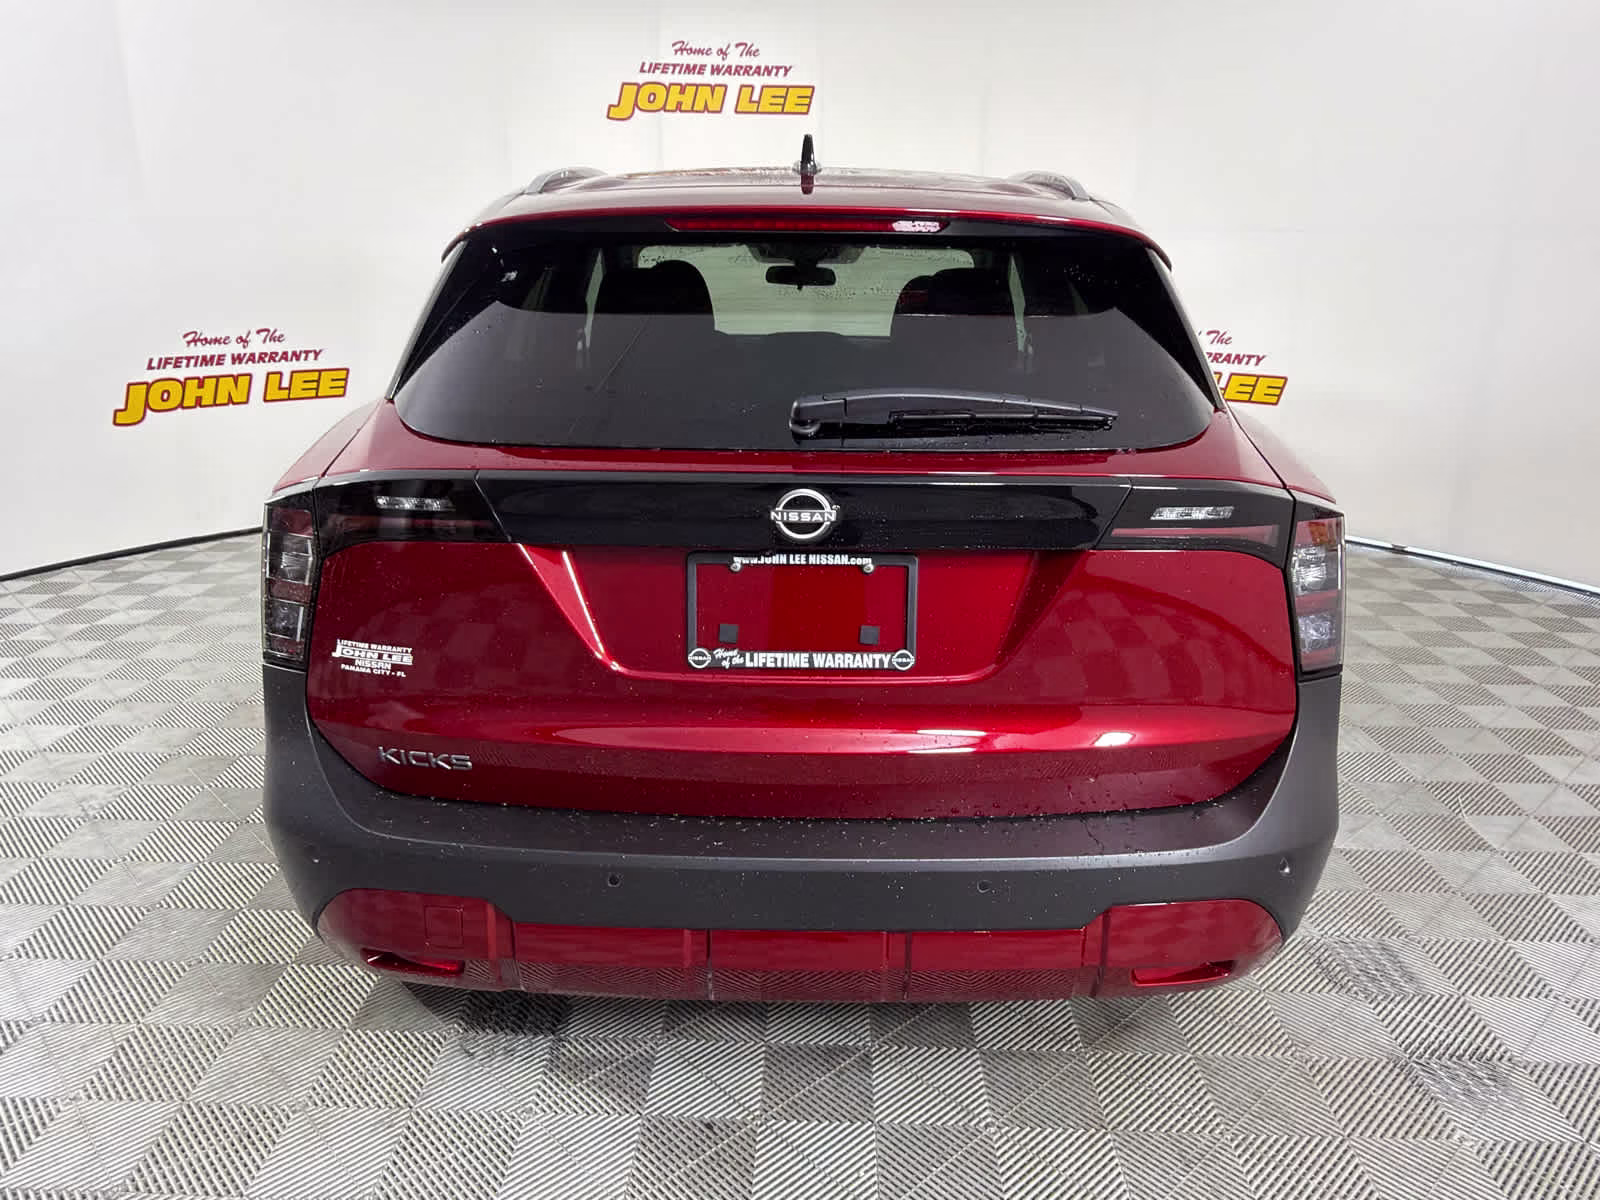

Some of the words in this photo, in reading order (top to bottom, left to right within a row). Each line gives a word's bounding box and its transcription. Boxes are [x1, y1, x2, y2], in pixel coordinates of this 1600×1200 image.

[671, 40, 713, 57] Home
[716, 45, 731, 61] of
[734, 42, 761, 57] The
[639, 62, 707, 76] LIFETIME
[710, 63, 793, 77] WARRANTY
[606, 81, 728, 121] JOHN
[734, 84, 815, 115] LEE
[182, 330, 231, 348] Home
[235, 331, 252, 349] of
[256, 328, 286, 344] The
[1206, 330, 1233, 345] The
[146, 353, 227, 371] LIFETIME
[230, 349, 324, 366] WARRANTY
[112, 373, 253, 427] JOHN
[263, 367, 350, 403] LEE
[770, 511, 837, 521] NISSAN
[789, 554, 806, 565] LEE
[808, 554, 872, 566] NISSAN.com
[331, 644, 379, 659] JOHN
[382, 653, 414, 664] LEE
[745, 652, 809, 668] LIFETIME
[812, 653, 892, 668] WARRANTY
[354, 659, 392, 670] NISSAN
[372, 667, 391, 676] CITY
[378, 746, 473, 771] KICKS
